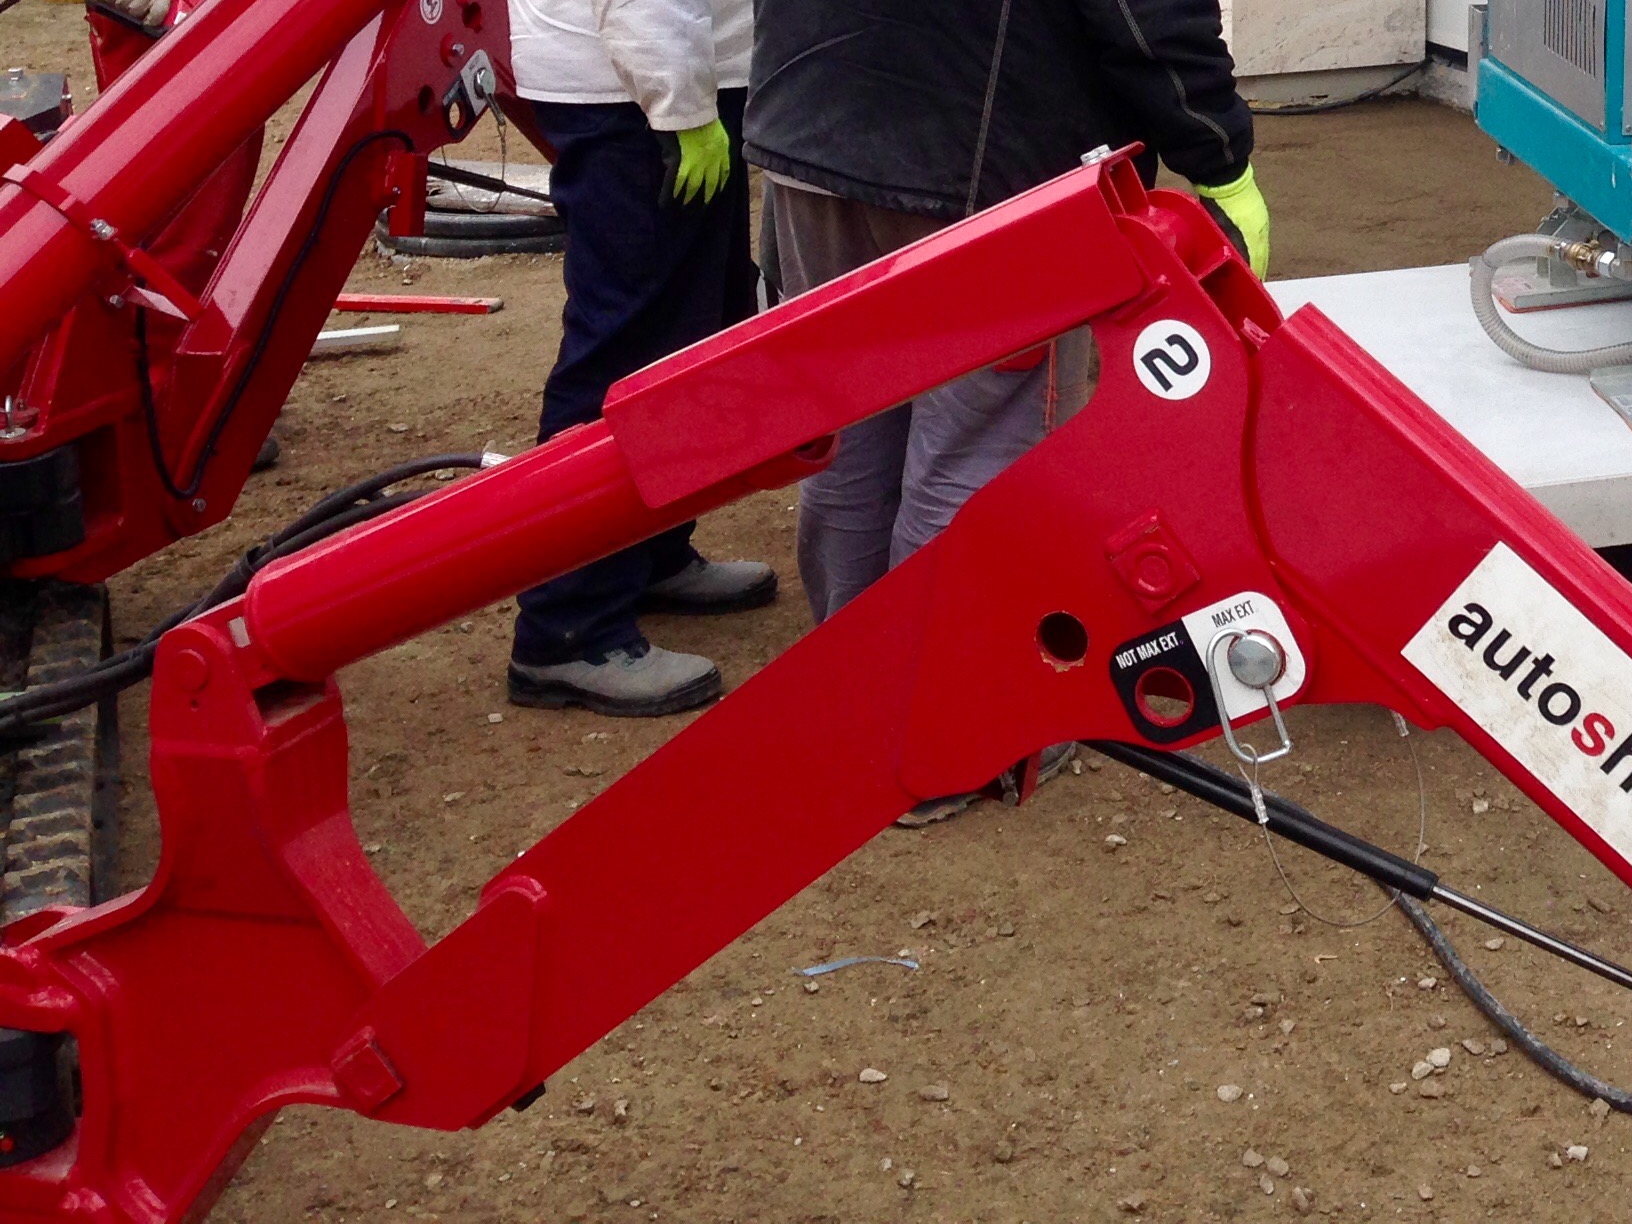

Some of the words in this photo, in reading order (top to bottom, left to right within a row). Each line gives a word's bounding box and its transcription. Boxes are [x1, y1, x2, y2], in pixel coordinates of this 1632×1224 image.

[1140, 333, 1199, 392] 2
[1211, 608, 1236, 628] MAX
[1235, 600, 1255, 619] EXT
[1115, 649, 1138, 669] NOT
[1136, 640, 1162, 661] MAX
[1160, 631, 1179, 649] EXT
